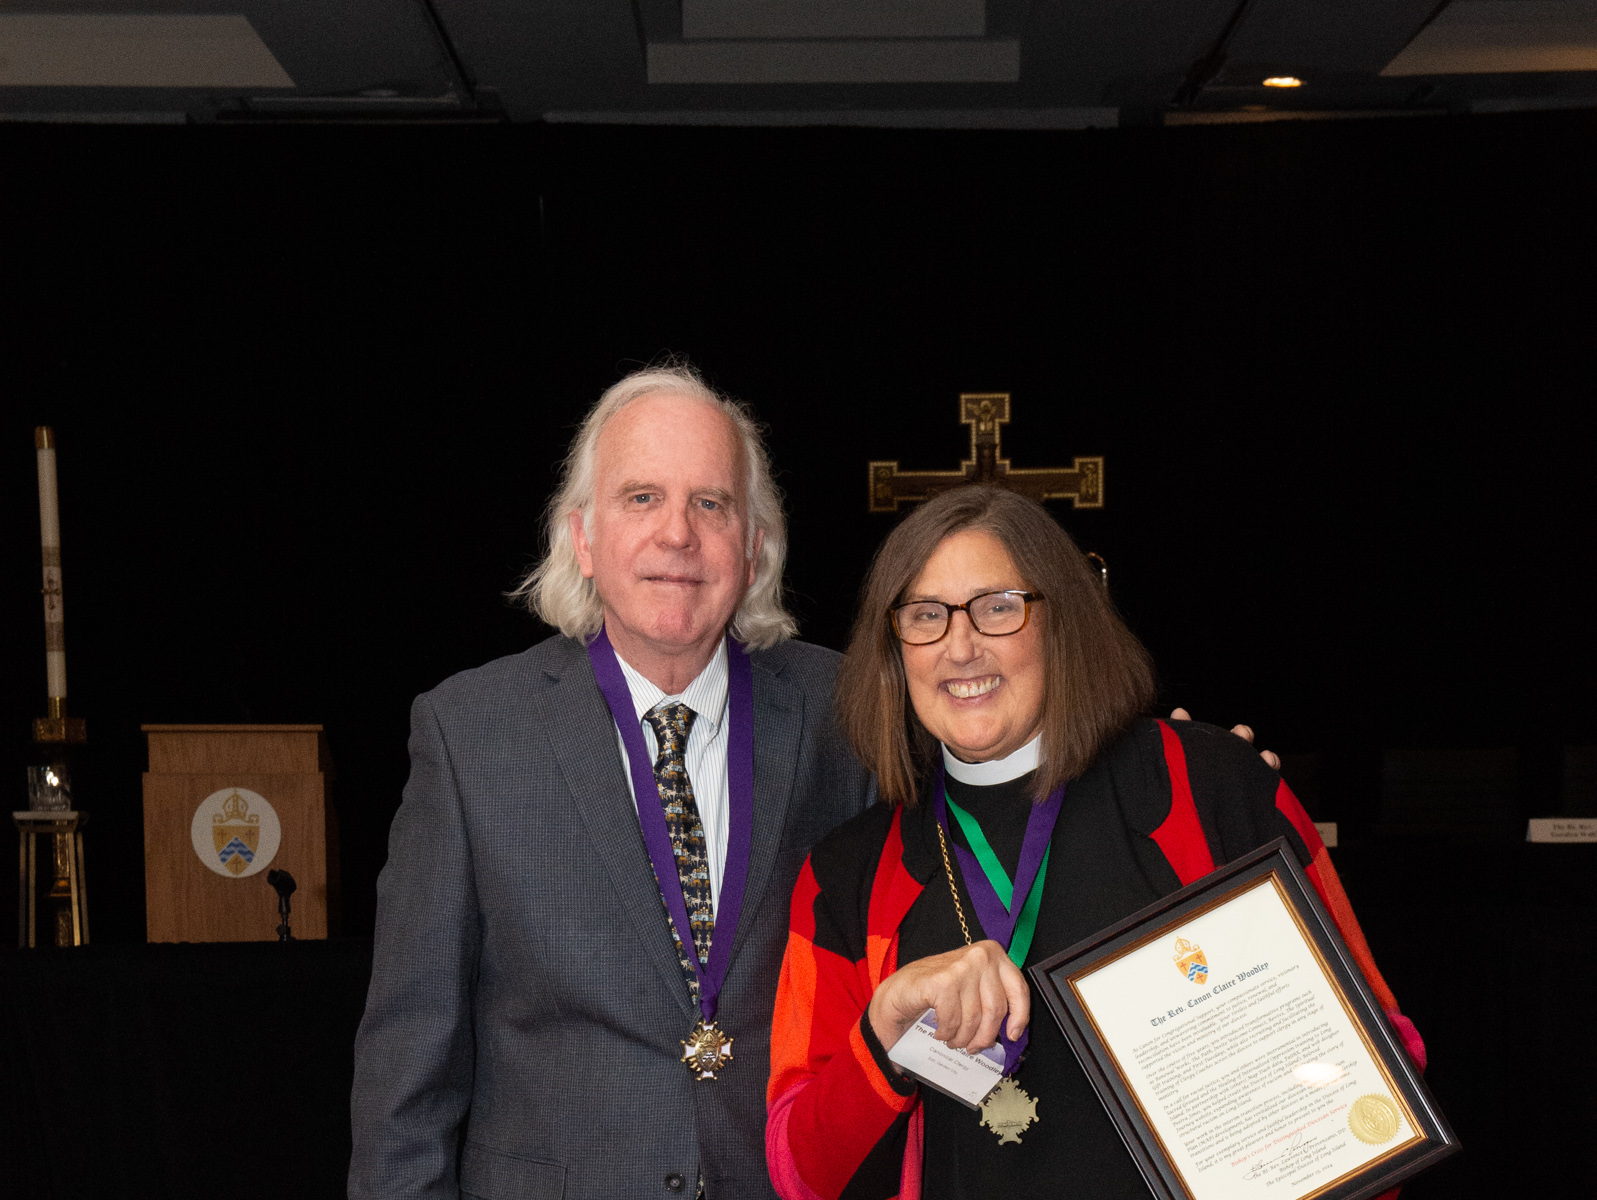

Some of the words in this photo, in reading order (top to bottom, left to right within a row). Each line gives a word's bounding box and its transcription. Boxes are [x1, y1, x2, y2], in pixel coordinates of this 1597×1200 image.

[1150, 1015, 1166, 1027] The
[1167, 1005, 1186, 1019] Rev.
[1186, 992, 1212, 1008] Canon
[1212, 979, 1236, 995] Claire
[1236, 962, 1269, 983] Woodley
[914, 1025, 928, 1035] The
[974, 1057, 1002, 1076] Woodley
